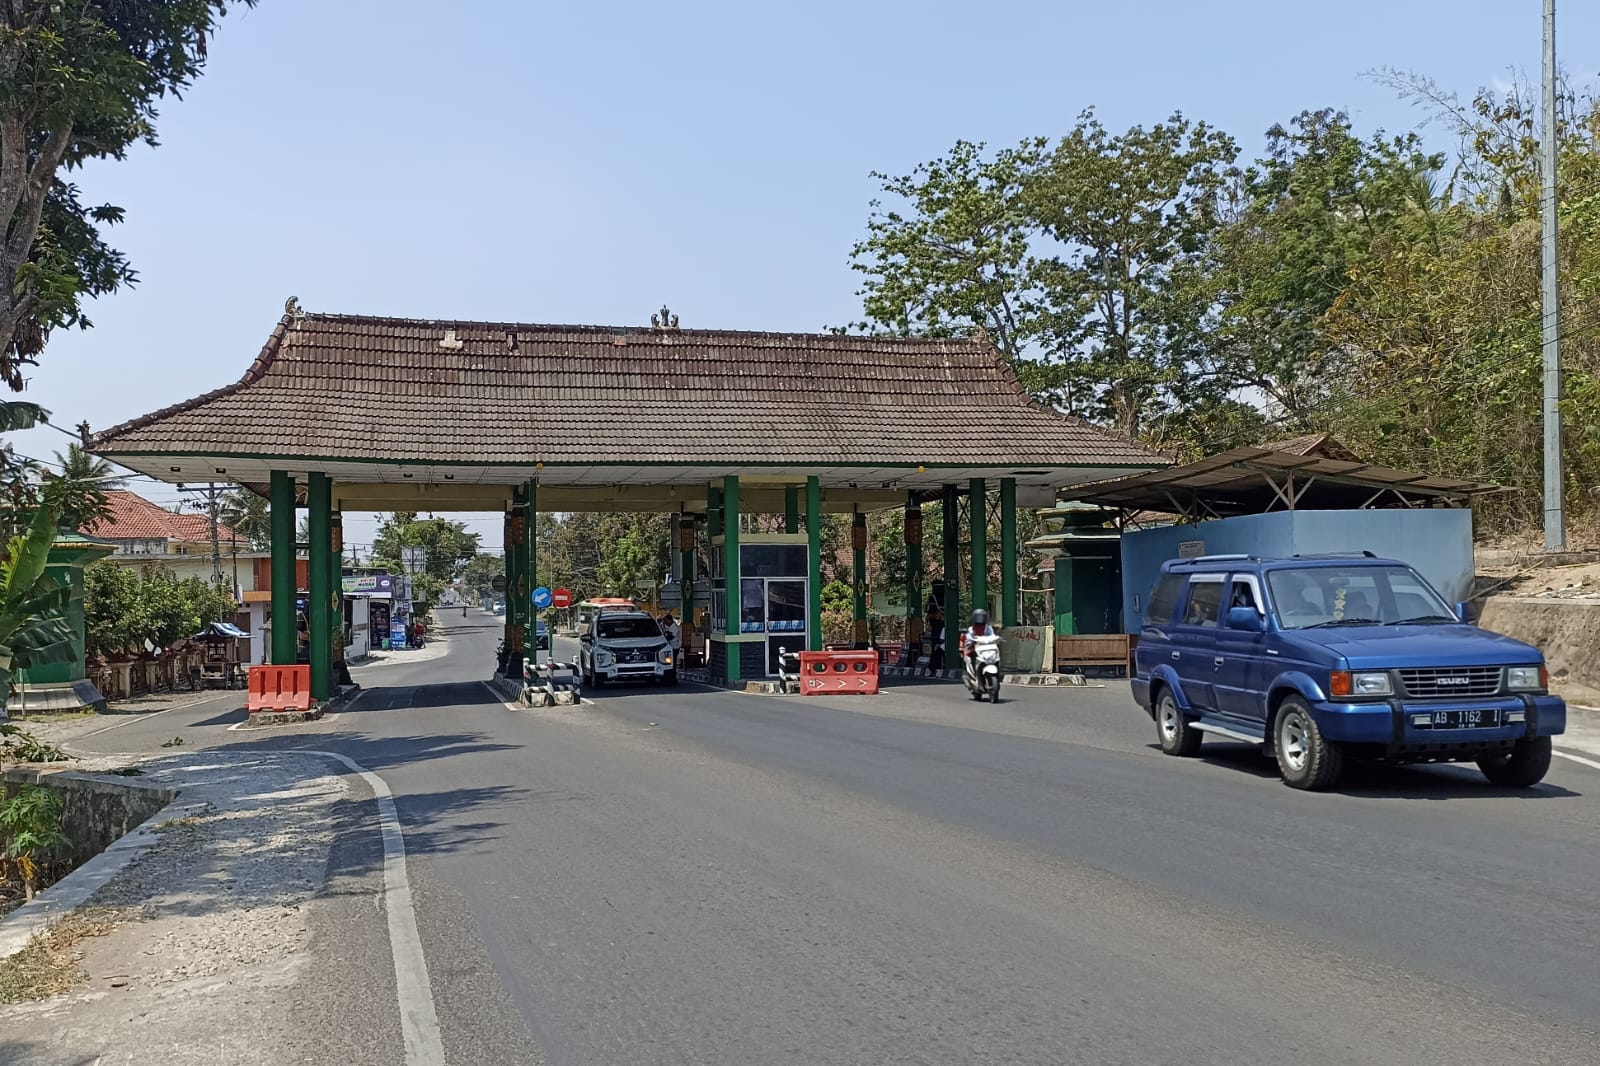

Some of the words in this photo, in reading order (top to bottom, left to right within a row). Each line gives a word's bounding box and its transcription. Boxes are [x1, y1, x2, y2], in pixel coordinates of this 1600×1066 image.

[1437, 677, 1469, 685] ISUZU
[1434, 711, 1447, 724] AB
[1458, 710, 1482, 723] 1162
